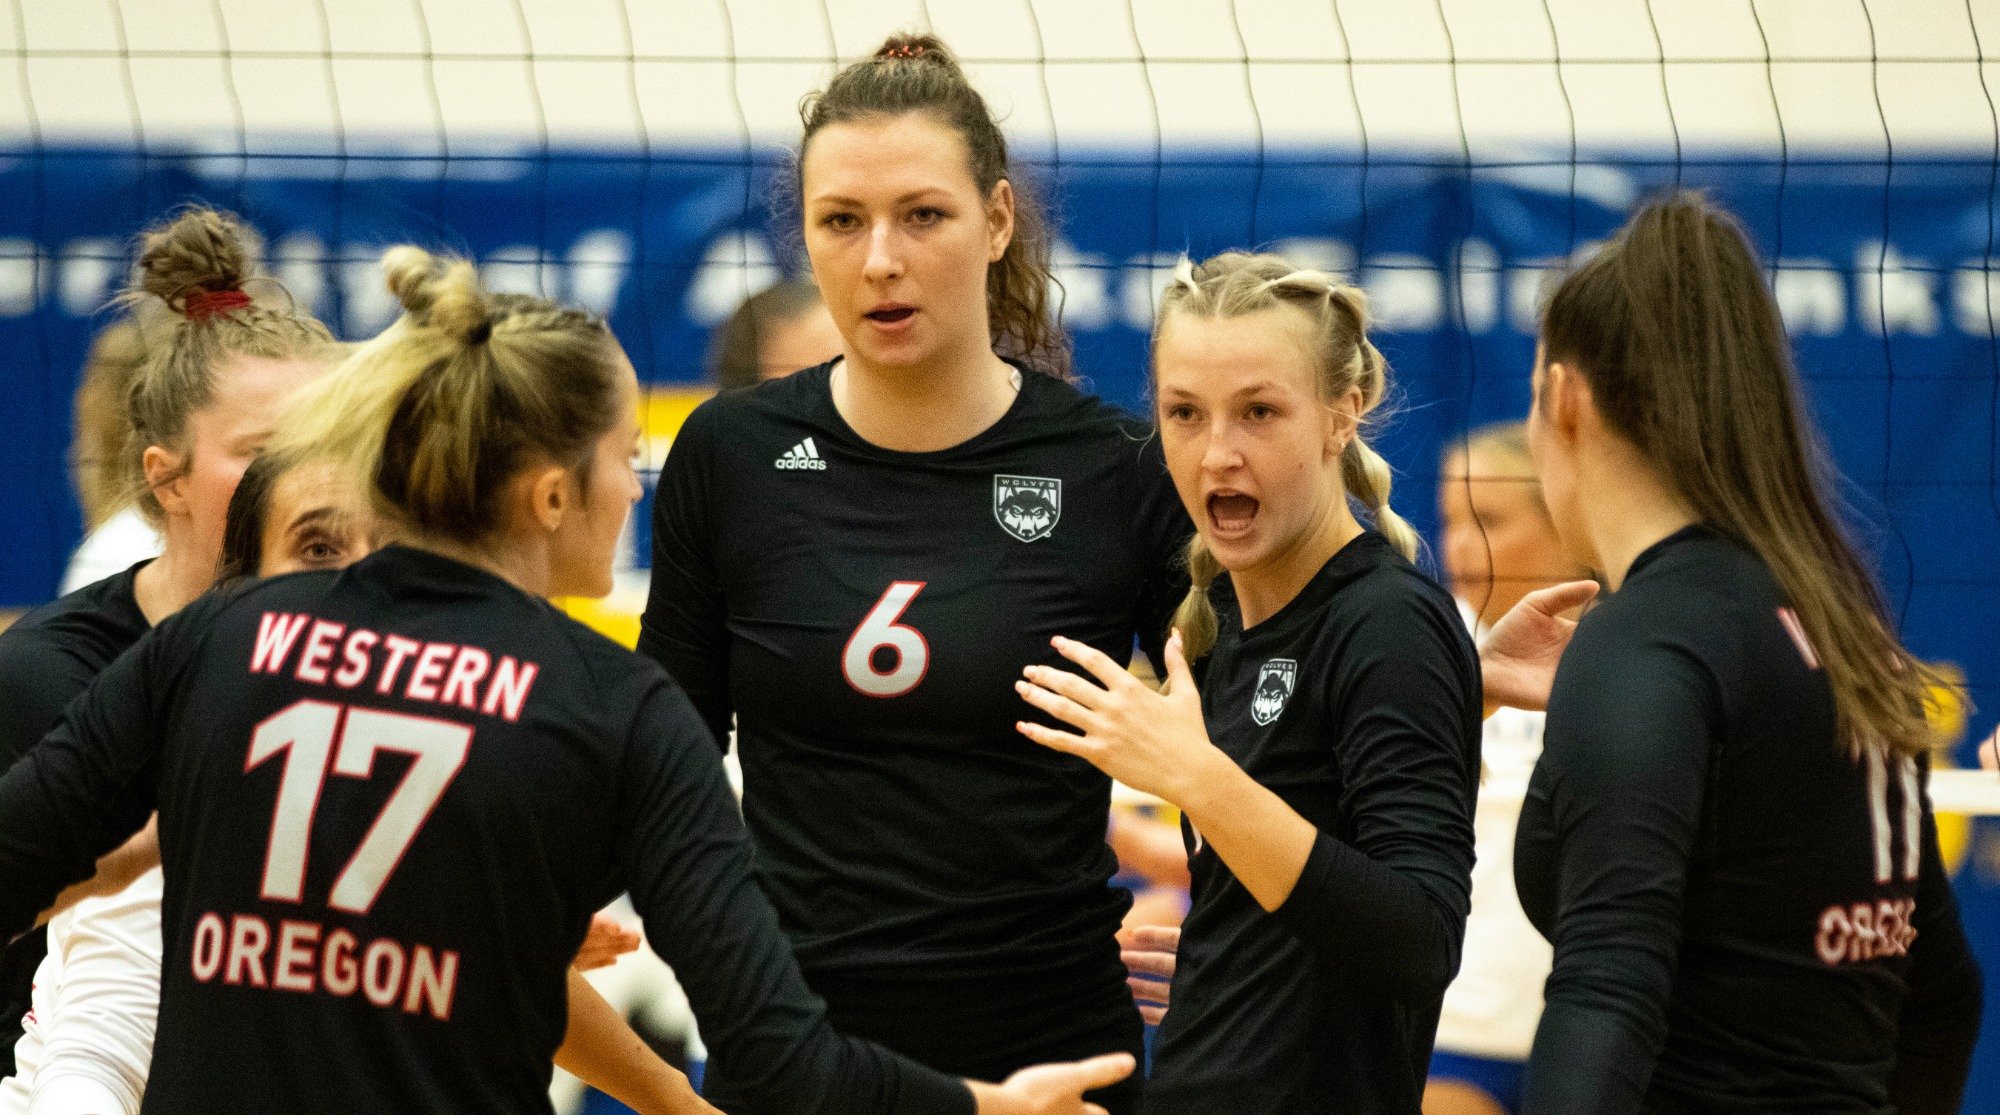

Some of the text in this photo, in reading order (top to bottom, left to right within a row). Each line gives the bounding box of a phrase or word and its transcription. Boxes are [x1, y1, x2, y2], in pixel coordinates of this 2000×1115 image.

[775, 456, 827, 470] adidas
[249, 612, 540, 722] WESTERN
[842, 580, 930, 697] 6
[244, 699, 475, 915] 17
[191, 912, 460, 1021] OREGON
